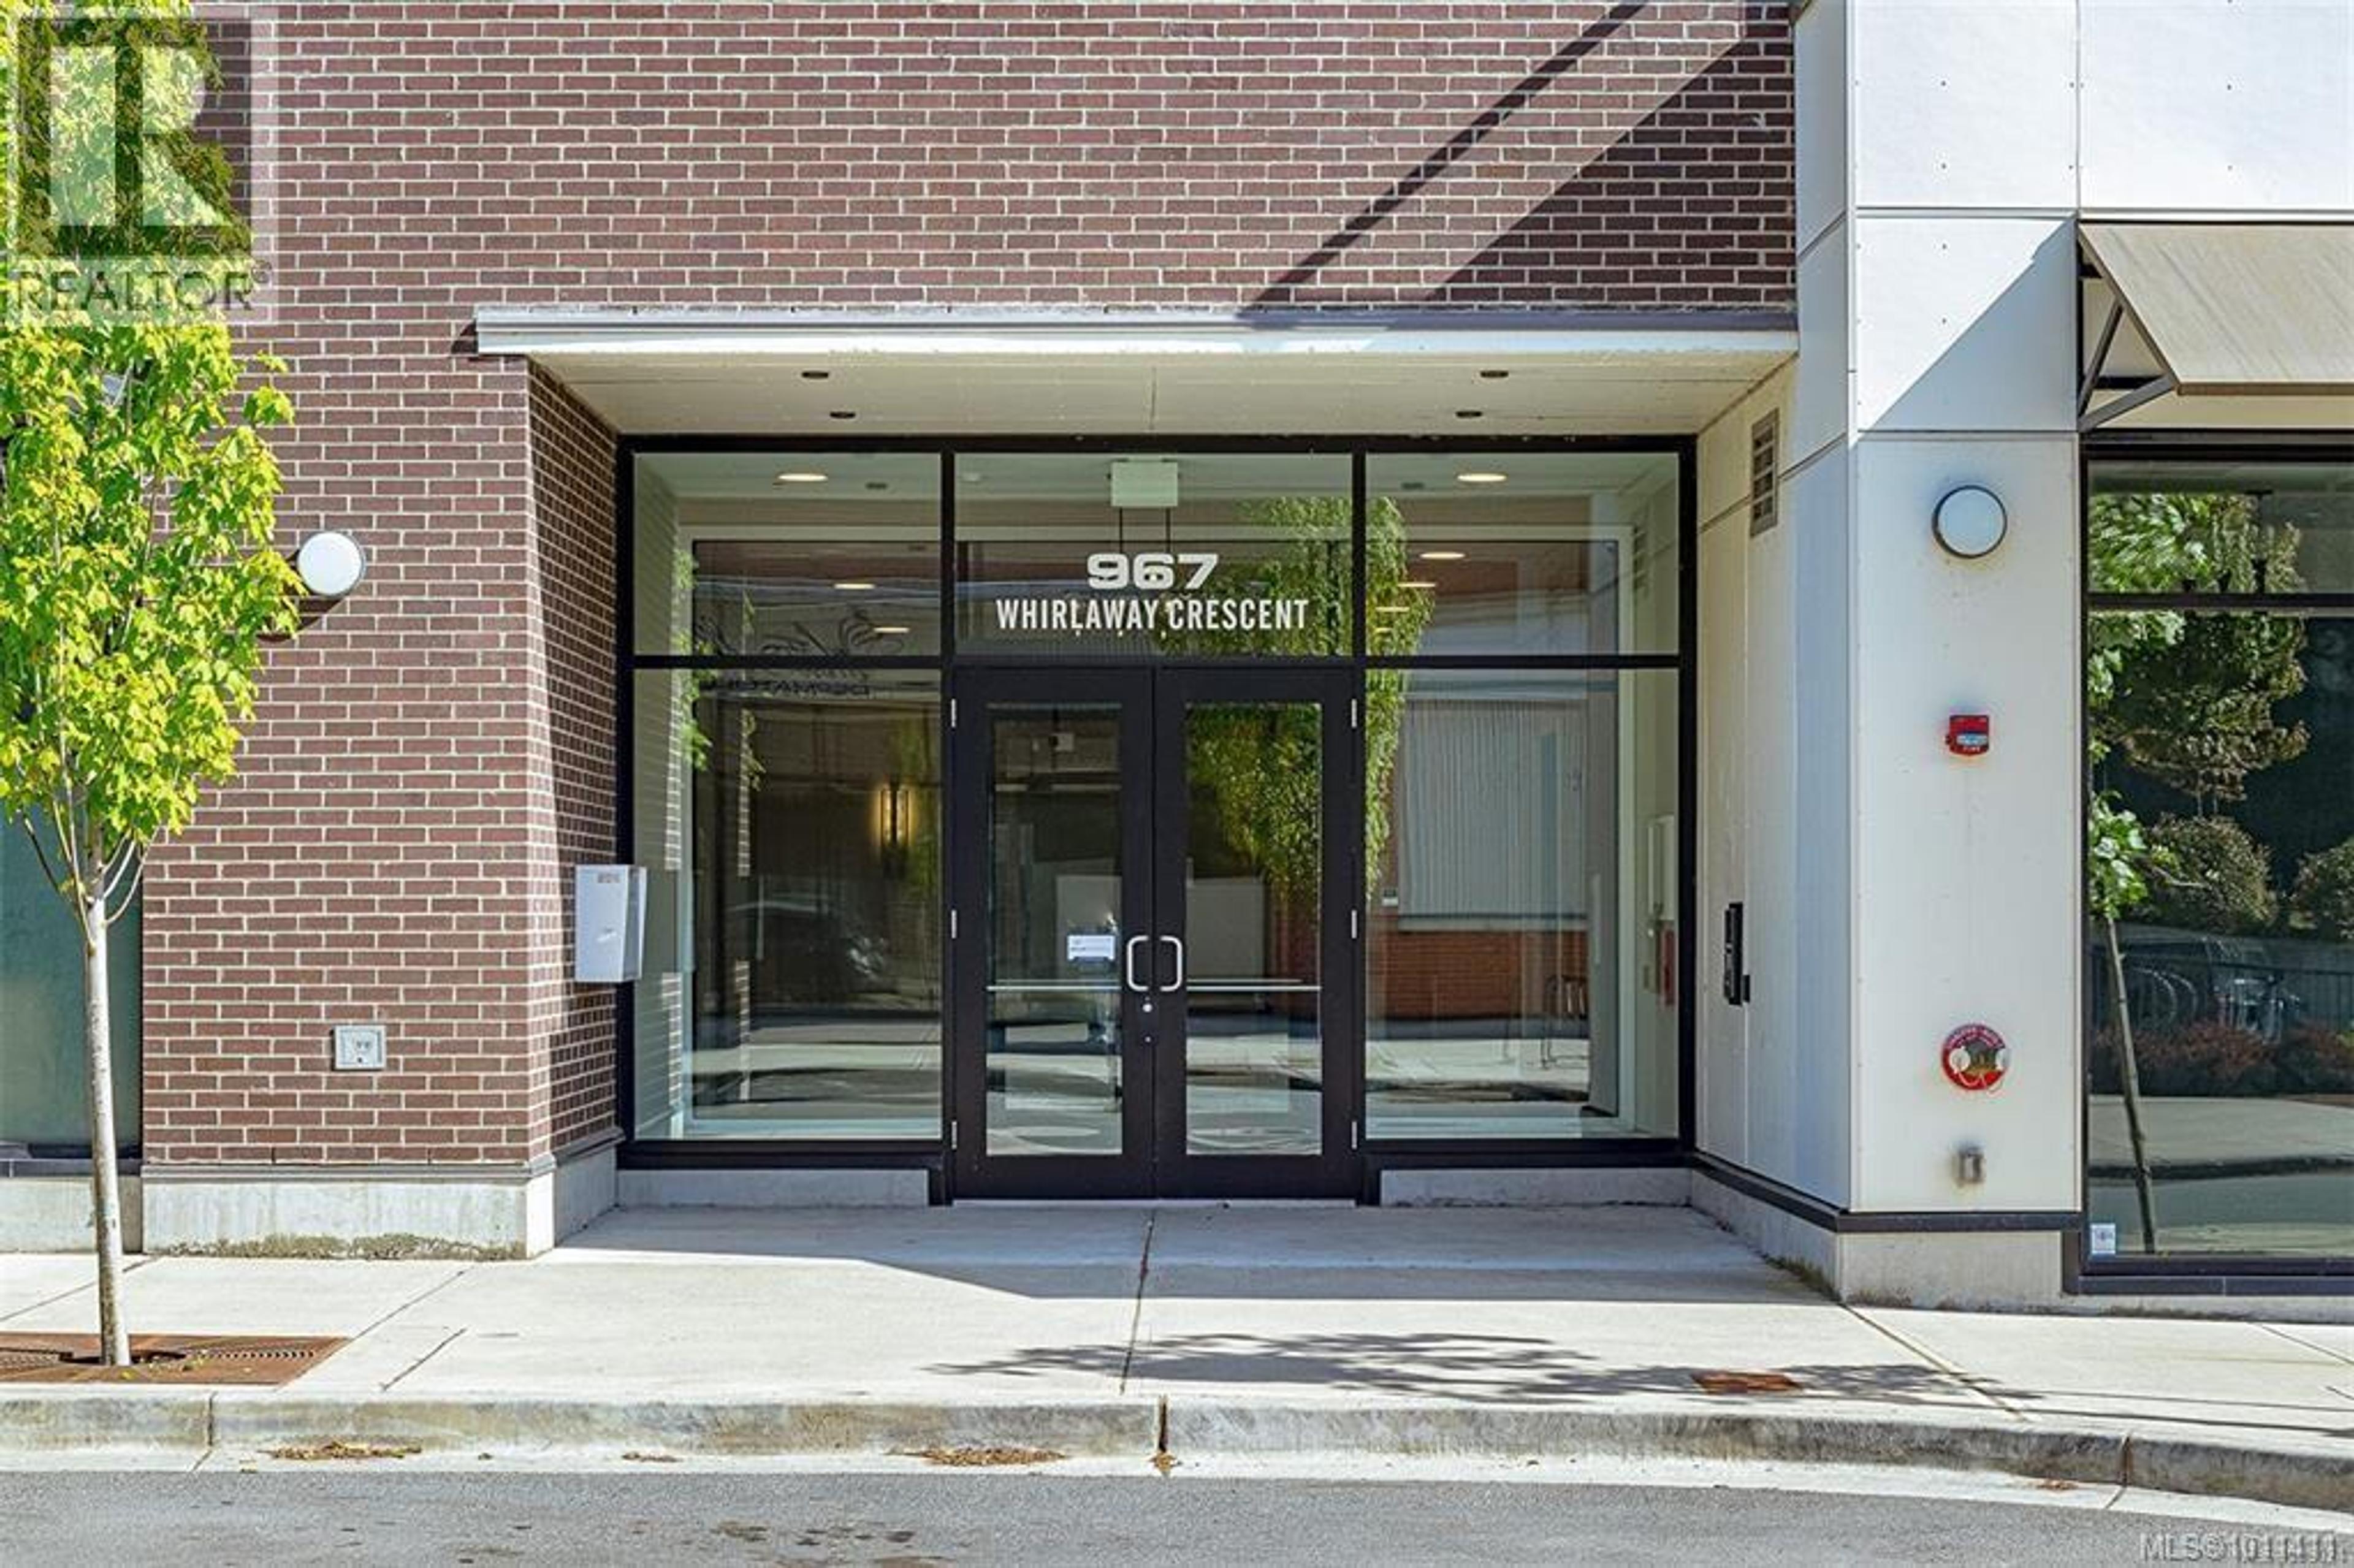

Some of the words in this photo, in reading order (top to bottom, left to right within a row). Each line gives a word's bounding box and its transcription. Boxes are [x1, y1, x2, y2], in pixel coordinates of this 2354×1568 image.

[1086, 553, 1219, 590] 967
[996, 598, 1160, 630] WHIRLAWAY
[1168, 598, 1309, 630] CRESCENT
